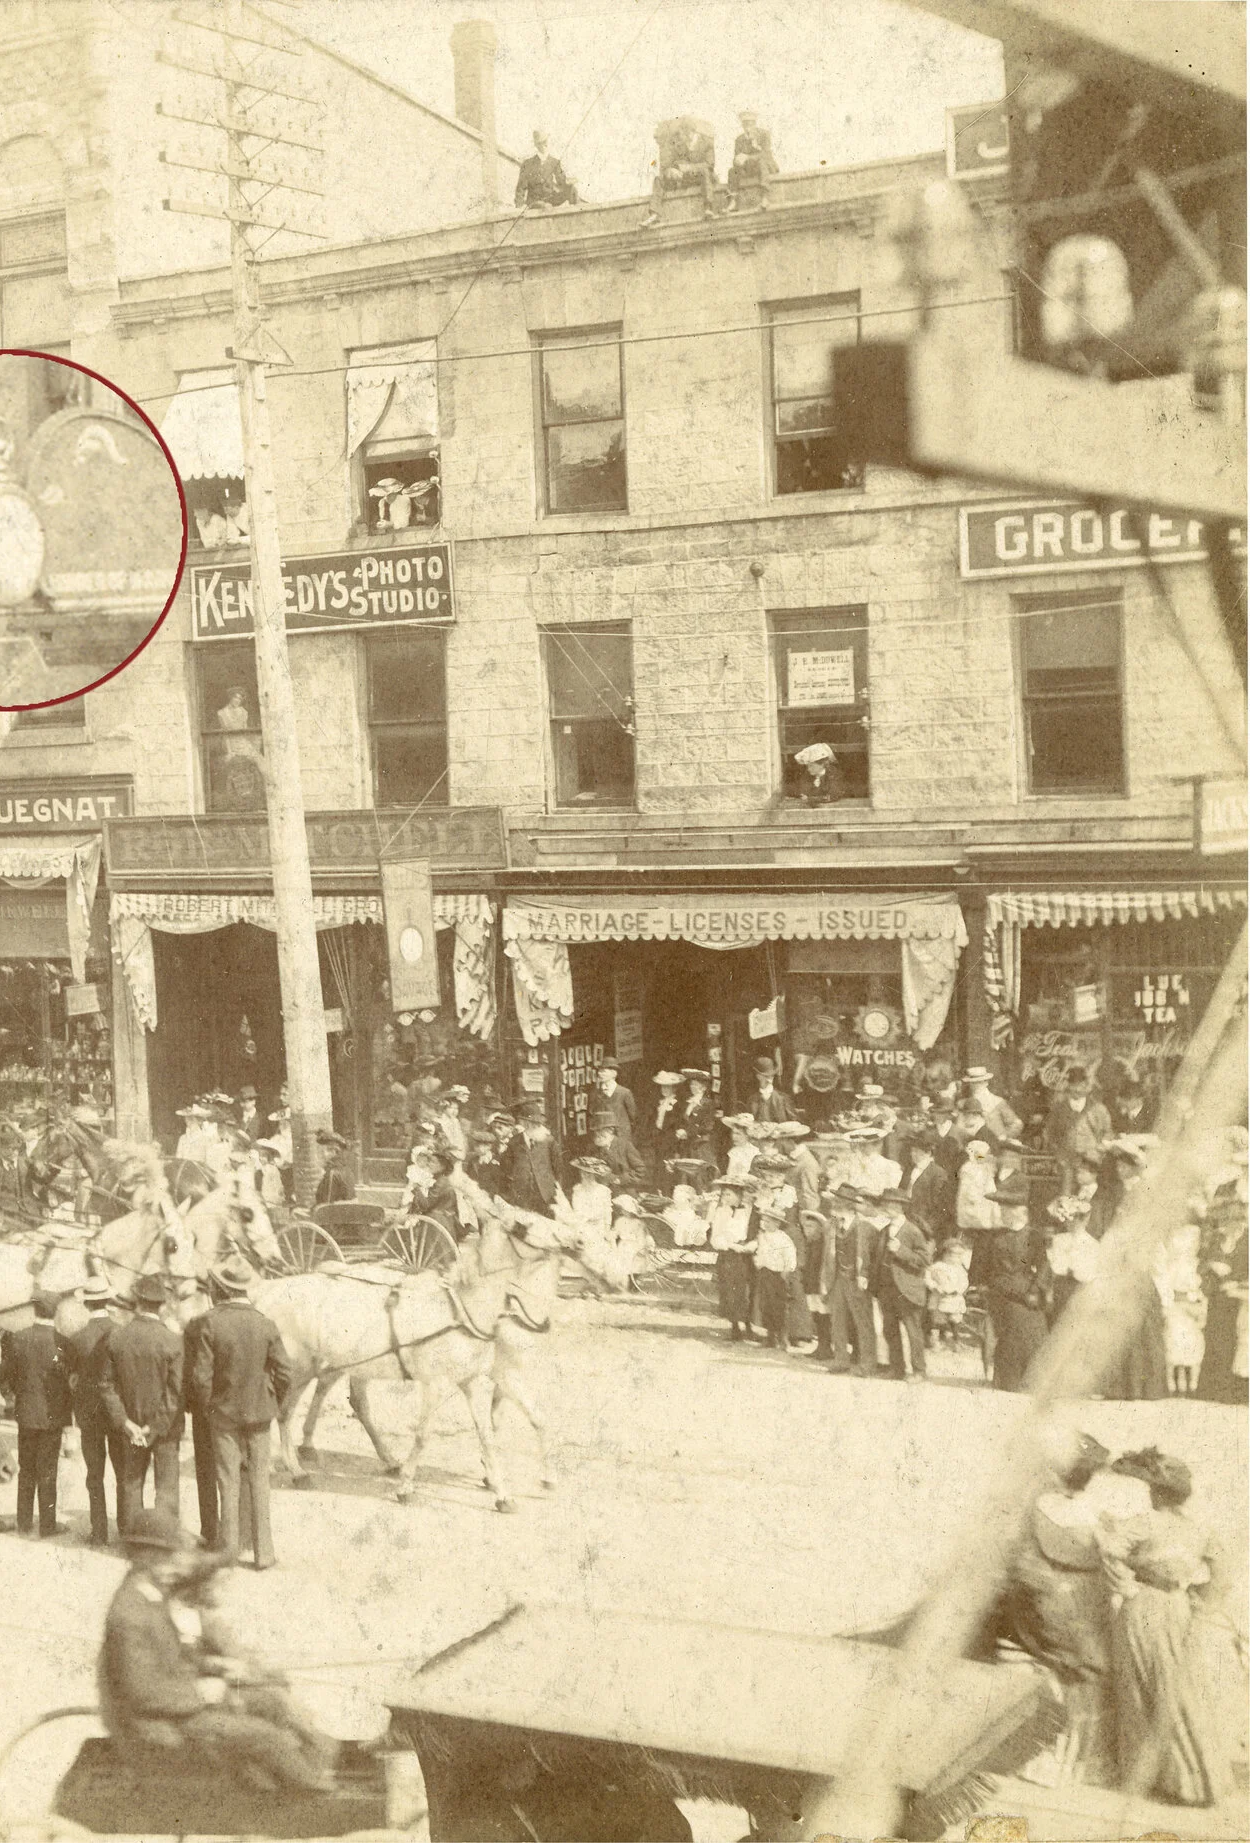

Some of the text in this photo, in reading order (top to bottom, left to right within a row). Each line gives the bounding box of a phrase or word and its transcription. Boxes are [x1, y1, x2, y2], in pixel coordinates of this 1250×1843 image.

[198, 556, 443, 628] KENEDY'S PHOTO
[164, 898, 233, 913] ROBERT
[527, 912, 648, 933] MARRIAGE
[669, 911, 787, 932] LICENSES
[836, 1045, 916, 1070] WATCHES
